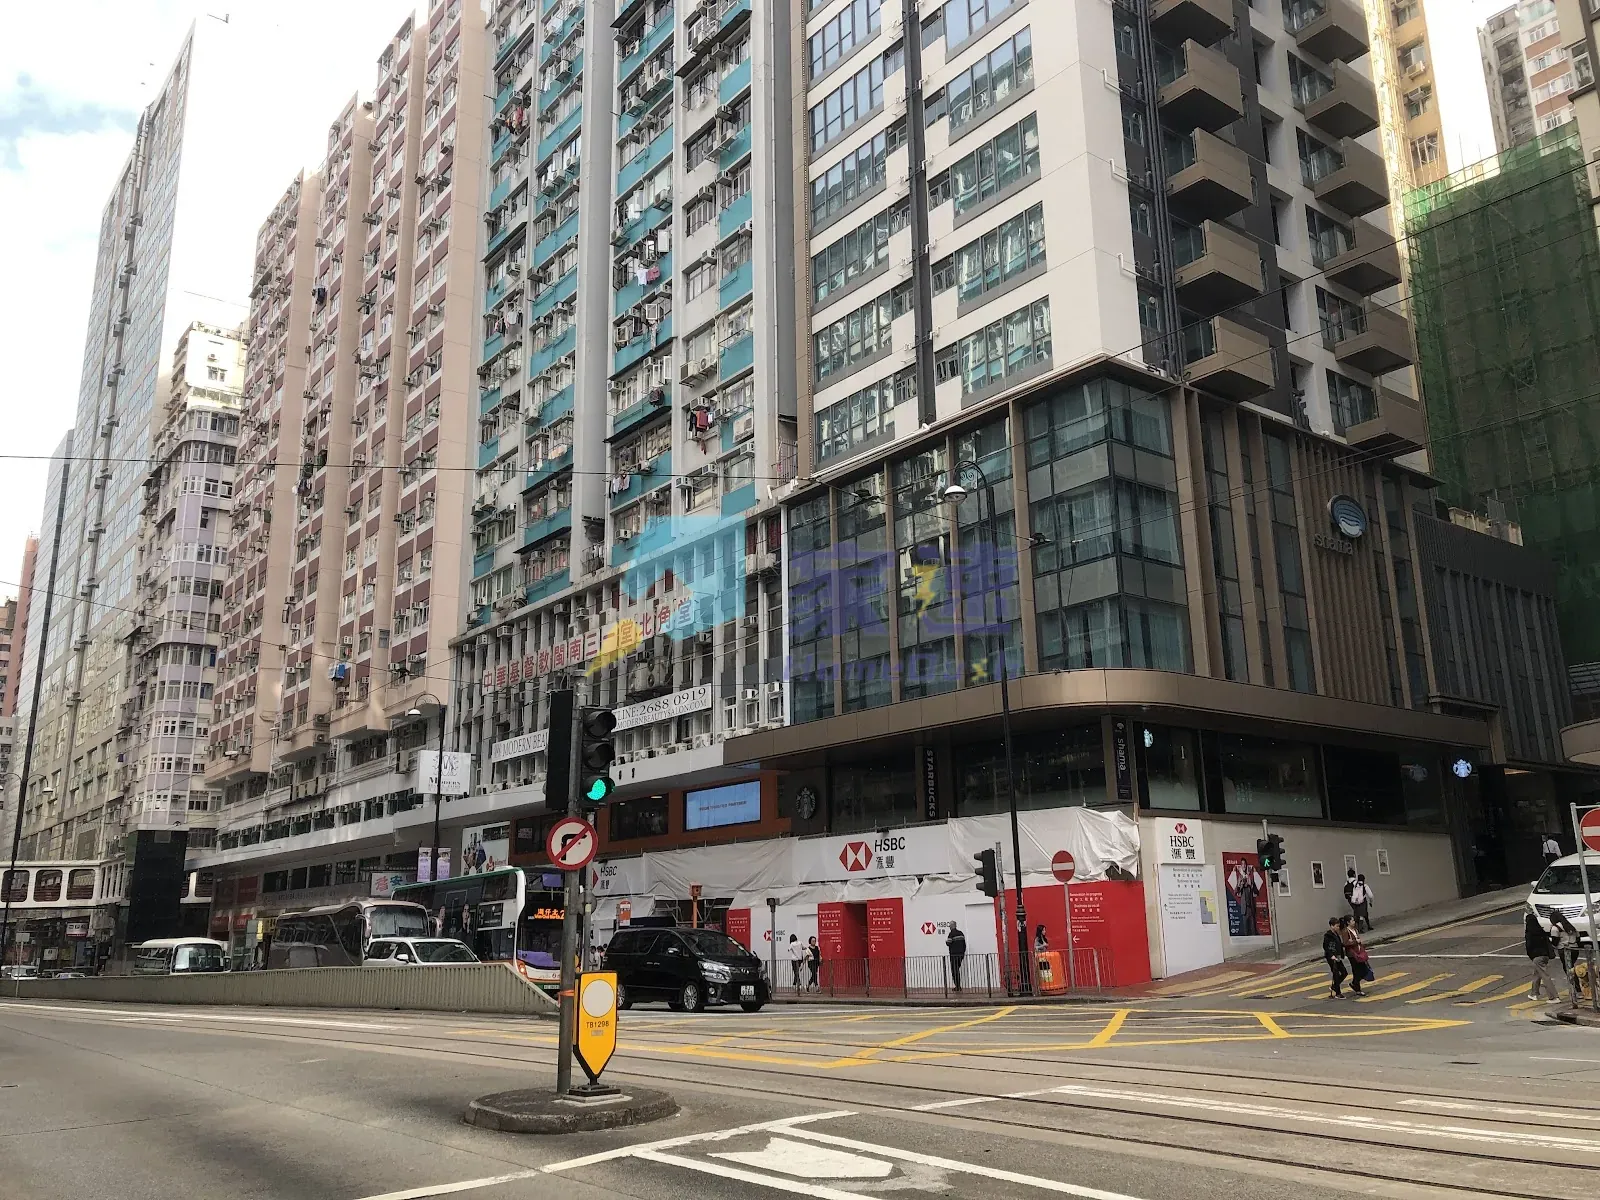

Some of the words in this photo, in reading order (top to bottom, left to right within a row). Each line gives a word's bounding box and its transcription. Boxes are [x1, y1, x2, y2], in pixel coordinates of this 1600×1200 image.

[673, 687, 706, 706] 0919
[502, 736, 532, 757] MODERN
[1117, 738, 1127, 771] shama
[428, 776, 461, 786] MDERN
[926, 749, 936, 818] STARBUCKS
[874, 836, 906, 852] HSBC
[1169, 835, 1195, 848] HSBC
[600, 865, 618, 877] HSBC
